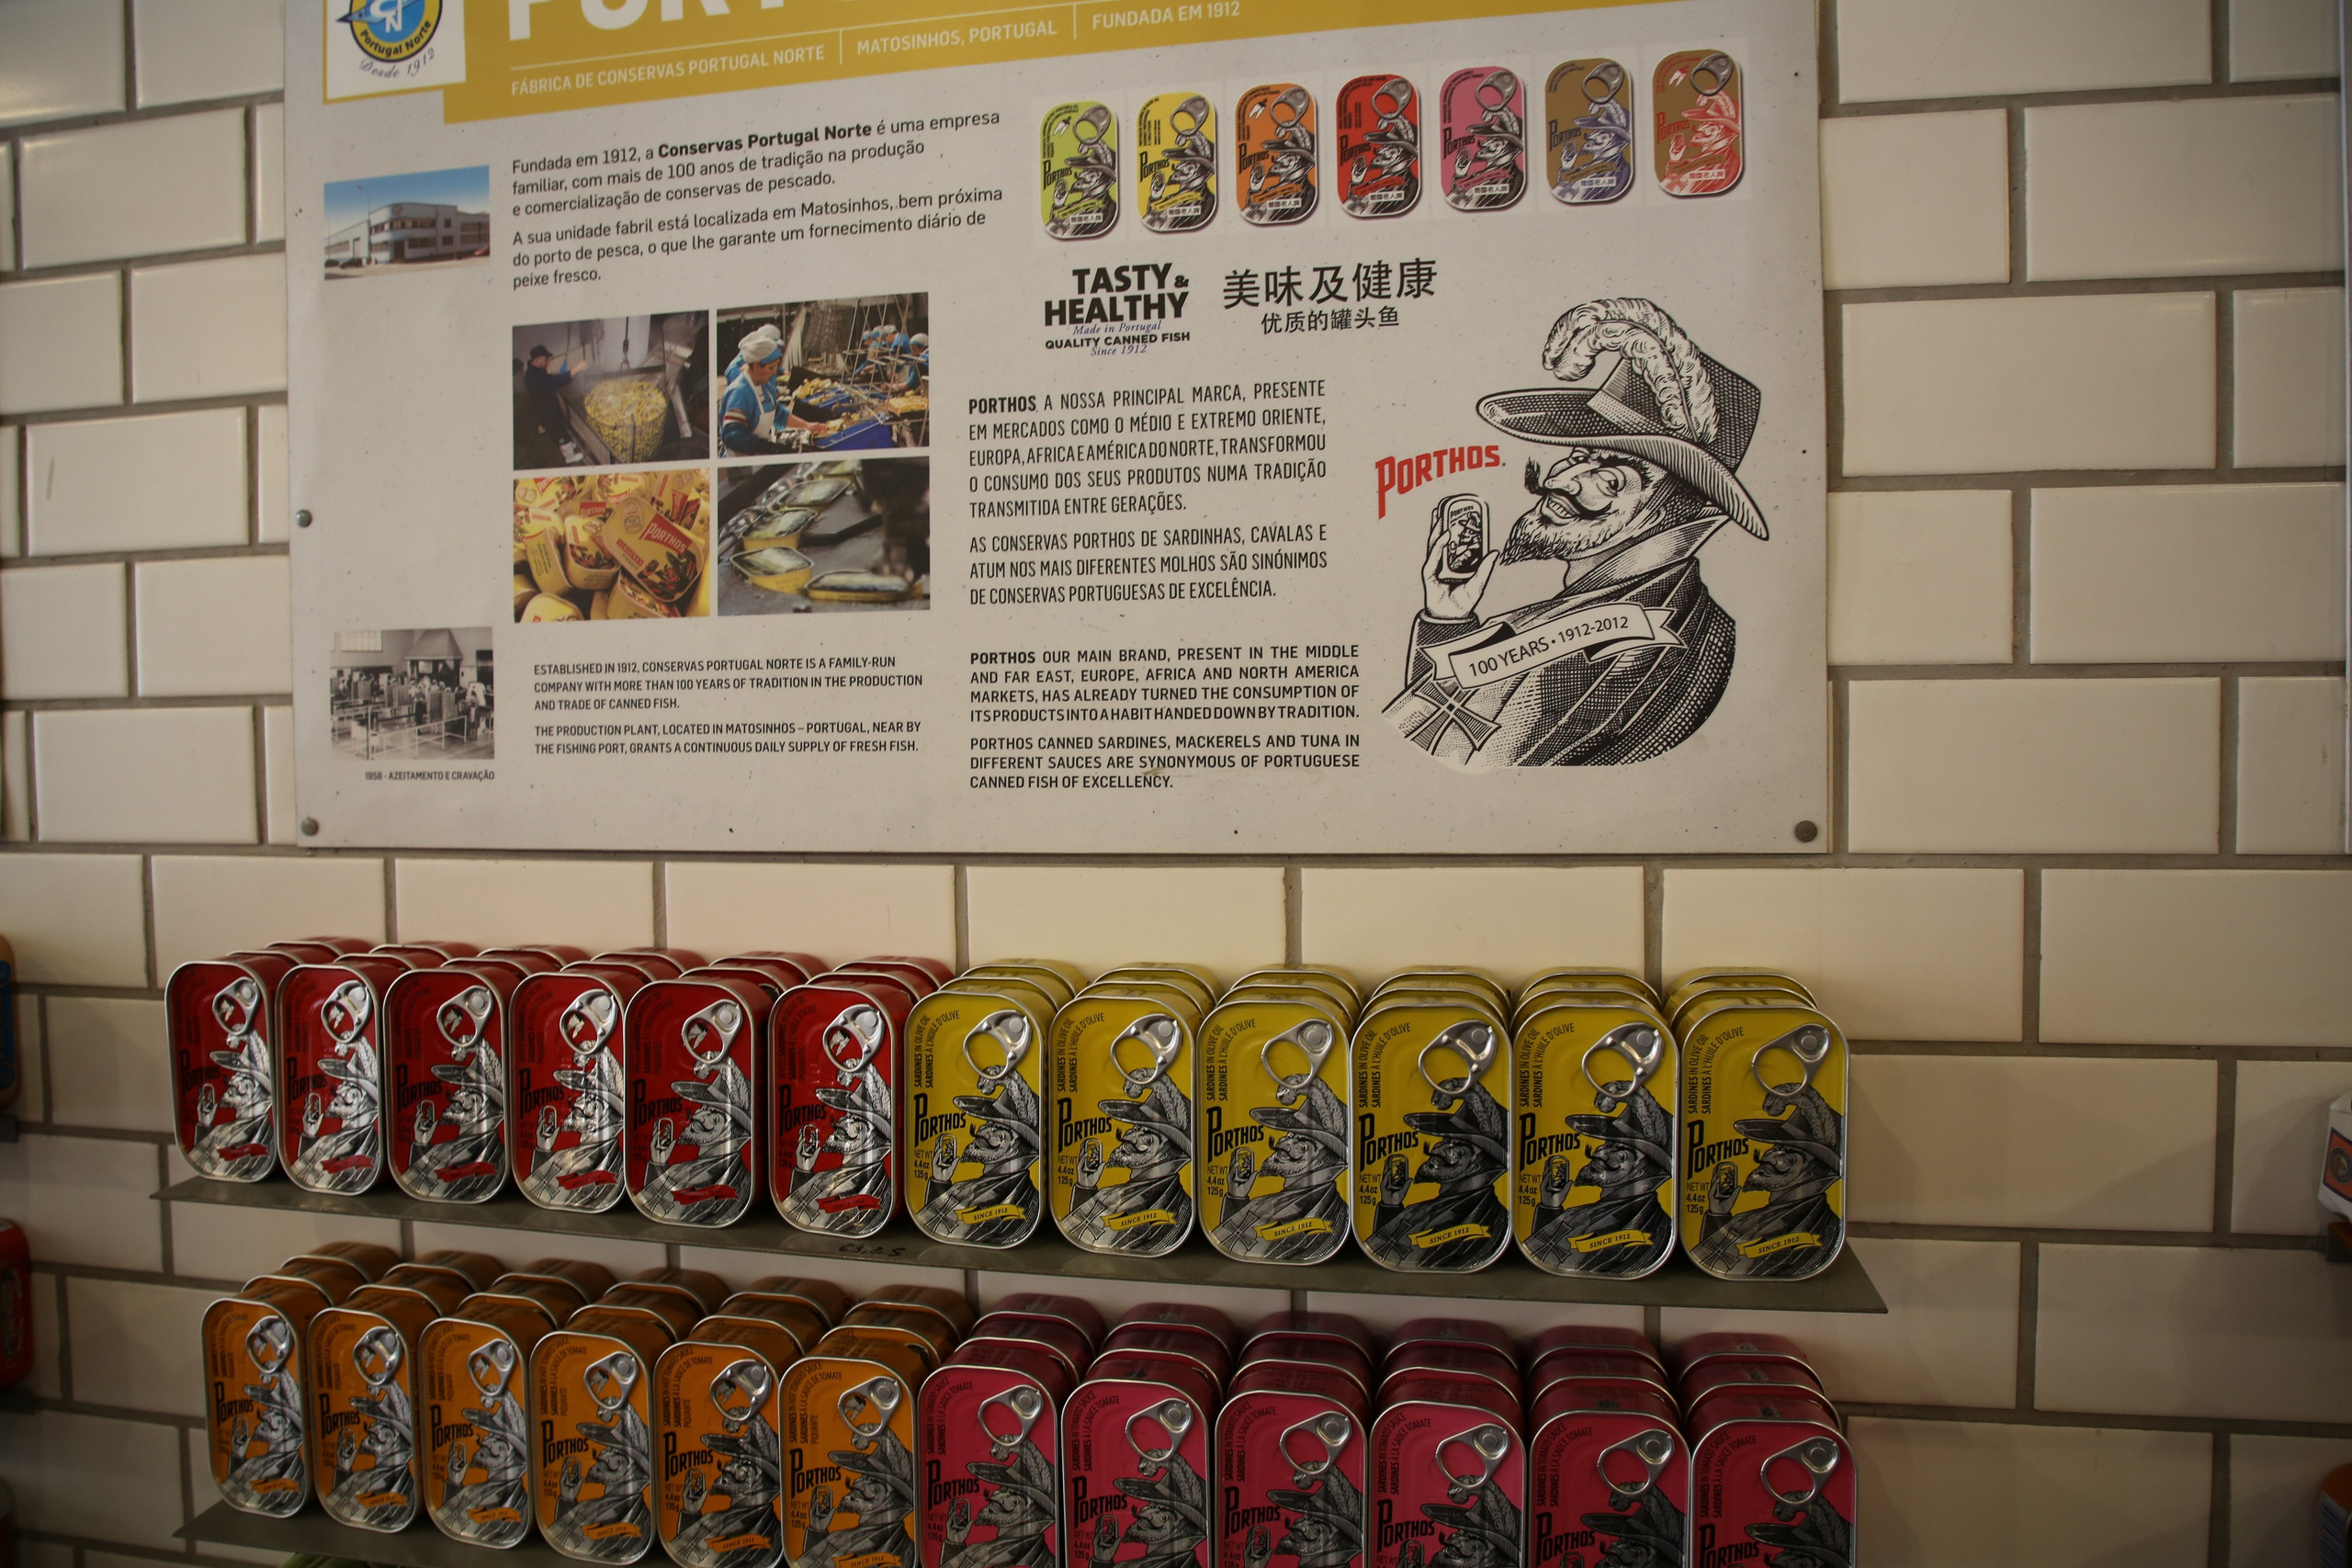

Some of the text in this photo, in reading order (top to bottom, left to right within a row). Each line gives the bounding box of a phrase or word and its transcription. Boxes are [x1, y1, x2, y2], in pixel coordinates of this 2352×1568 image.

[858, 20, 1057, 55] MATOSINHOS, PORTUGAL
[1093, 1, 1239, 28] FUNDADA EM 1912
[360, 19, 432, 58] Portugal Norte
[358, 48, 435, 78] Desde 1912
[513, 46, 824, 96] FÁBRICA DE CONSERVAS PORTUGAL NORTE
[513, 113, 999, 174] Fundada em 1912, a Conservas Portugal Norte é uma empresa
[514, 188, 1001, 245] A sua unidade fabril está localizada em Matosinhos, bem próxima
[1072, 263, 1189, 294] TASTY &
[1223, 257, 1437, 310] 美味及健康
[1045, 291, 1189, 326] HEALTHY
[1073, 321, 1161, 335] Made in Portugal
[1261, 305, 1399, 334] 优质的罐头鱼
[1046, 332, 1190, 349] QUALITY CANNED FISH
[1091, 344, 1147, 356] Since 1912
[969, 380, 1325, 414] PORTHOS A NOSSA PRINCIPAL MARCA, PRESENTE
[1375, 446, 1499, 519] PORTHOS
[647, 523, 687, 553] PORTHOS
[971, 577, 1275, 604] DE CONSERVAS PORTUGUESAS DE EXCELÊNCIA.
[535, 657, 895, 675] ESTABLISHED IN 1912, CONSERVAS PORTUGAL NORTE IS A FAMILY-RUN
[971, 645, 1359, 664] PORTHOS OUR MAIN BRAND, PRESENT IN THE MIDDLE
[1469, 616, 1628, 676] 100 YEARS 1912-2012
[535, 698, 679, 710] AND TRADE OF CANNED FISH.
[971, 685, 1359, 704] MARKETS, HAS ALREADY TURNED THE CONSUMPTION OF
[389, 772, 444, 780] AZEITAMENTO
[452, 770, 494, 782] CRAVAÇÃO
[1520, 1028, 1541, 1108] SARDINES IN OLIVE OIL
[1533, 1071, 1543, 1108] SARDINES
[1546, 1022, 1575, 1040] D'OLIVE
[913, 1092, 967, 1148] PORTHOS
[1057, 1097, 1113, 1154] PORTHOS
[1205, 1106, 1264, 1164] PORTHOS
[1358, 1112, 1419, 1172] PORTHOS
[1519, 1112, 1581, 1172] PORTHOS
[1687, 1119, 1749, 1181] PORTHOS
[1519, 1174, 1542, 1184] NET WT
[1273, 1221, 1313, 1236] SINCE 1912
[1430, 1226, 1470, 1245] SINCE 1912
[1589, 1233, 1631, 1249] SINCE 1912
[1758, 1235, 1800, 1254] SINCE 1912
[214, 1381, 254, 1428] PORTHOS
[319, 1393, 361, 1440] PORTHOS
[429, 1404, 473, 1452] PORTHOS
[540, 1419, 589, 1469] PORTHOS
[810, 1414, 819, 1444] PIQUANTE
[663, 1430, 714, 1482] PORTHOS
[789, 1448, 842, 1500] PORTHOS
[927, 1459, 980, 1511] PORTHOS
[1072, 1475, 1127, 1529] PORTHOS
[1224, 1486, 1281, 1540] PORTHOS
[1376, 1498, 1435, 1554] PORTHOS
[1536, 1511, 1596, 1568] PORTHOS
[1699, 1522, 1759, 1568] PORTHOS
